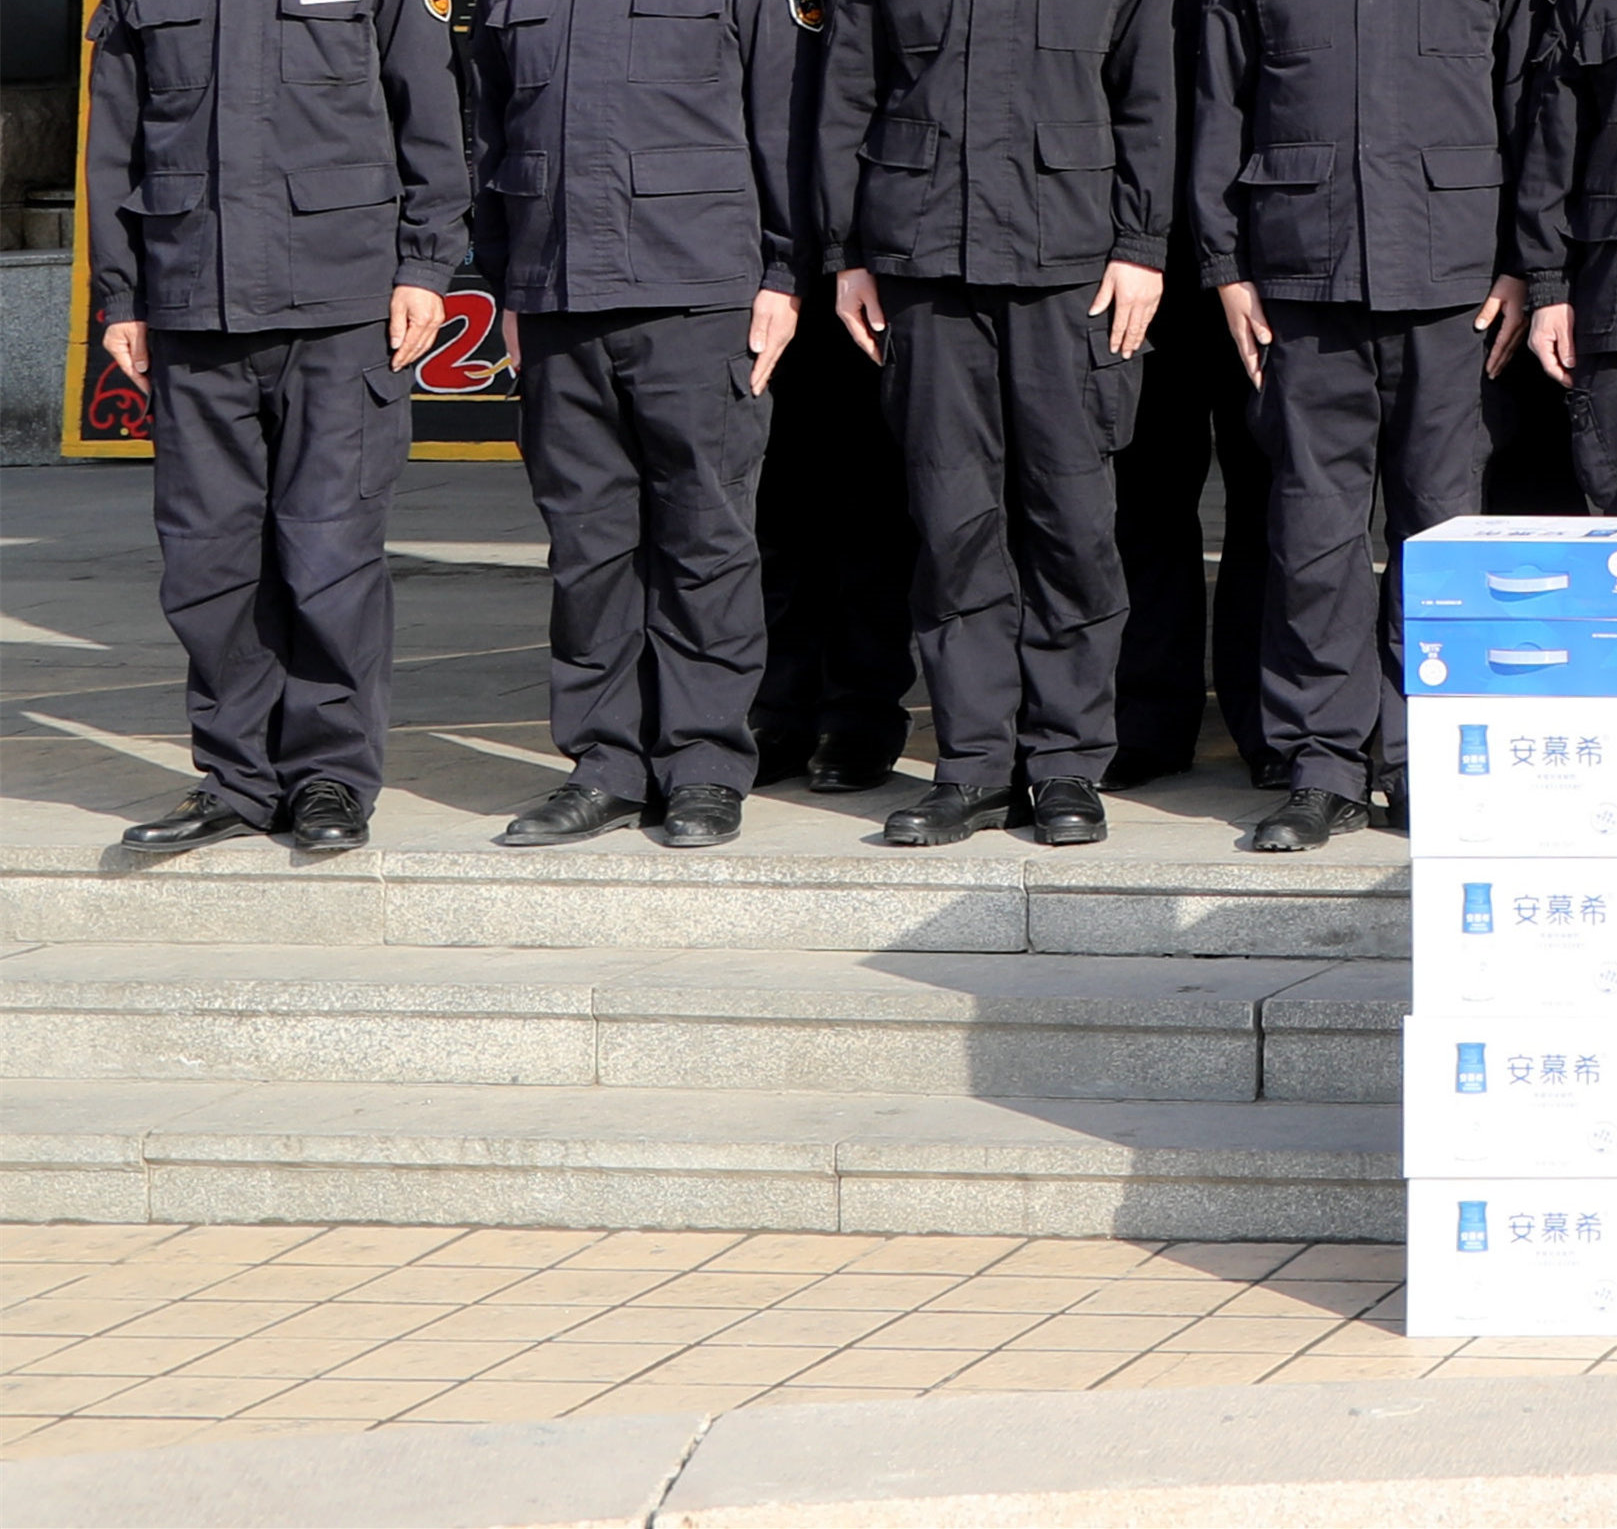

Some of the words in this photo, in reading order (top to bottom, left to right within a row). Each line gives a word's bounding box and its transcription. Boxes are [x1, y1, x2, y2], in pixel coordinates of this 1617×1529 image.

[1508, 735, 1604, 768] 安慕希
[1512, 894, 1608, 927] 安慕希
[1506, 1053, 1602, 1086] 安慕希
[1506, 1211, 1605, 1245] 安慕希
